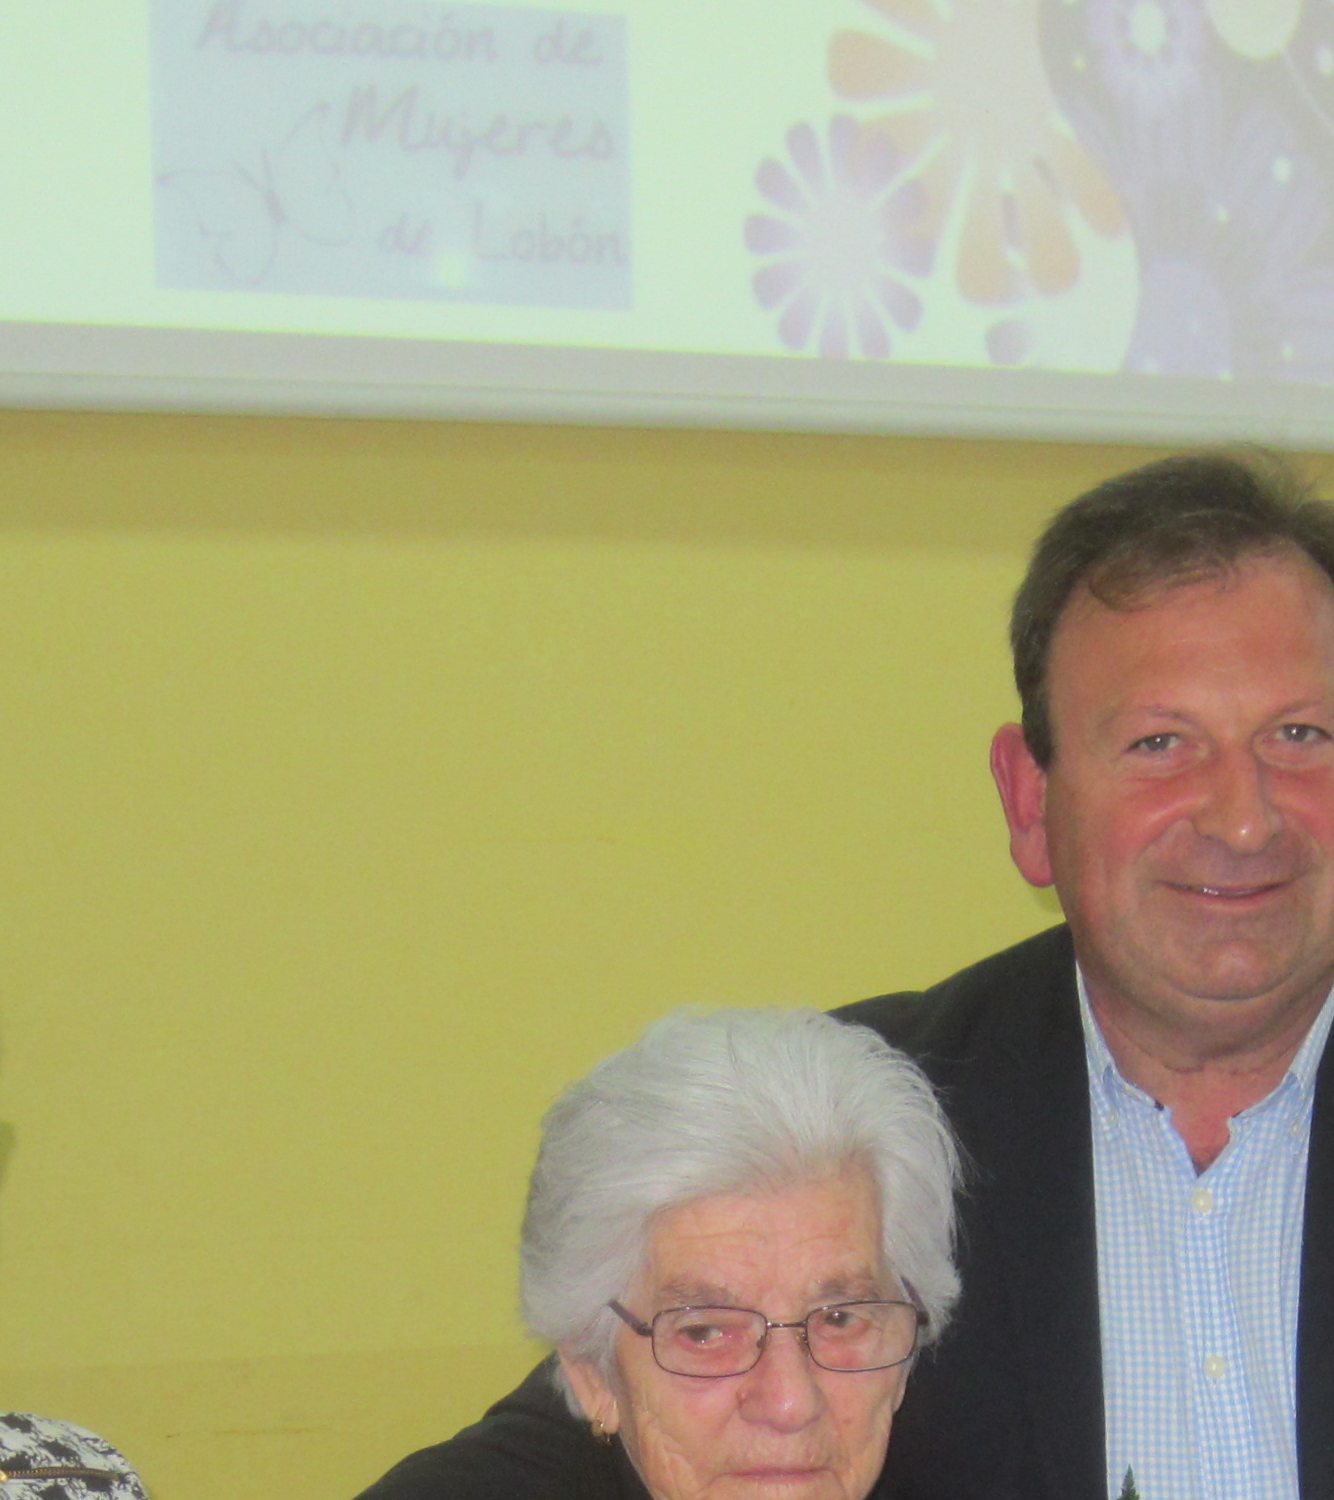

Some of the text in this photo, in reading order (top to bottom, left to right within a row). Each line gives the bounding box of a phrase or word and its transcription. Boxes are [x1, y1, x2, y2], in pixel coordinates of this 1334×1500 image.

[197, 0, 604, 66] Asociación de
[341, 83, 613, 180] Mujeres
[378, 201, 628, 264] de Lobón
